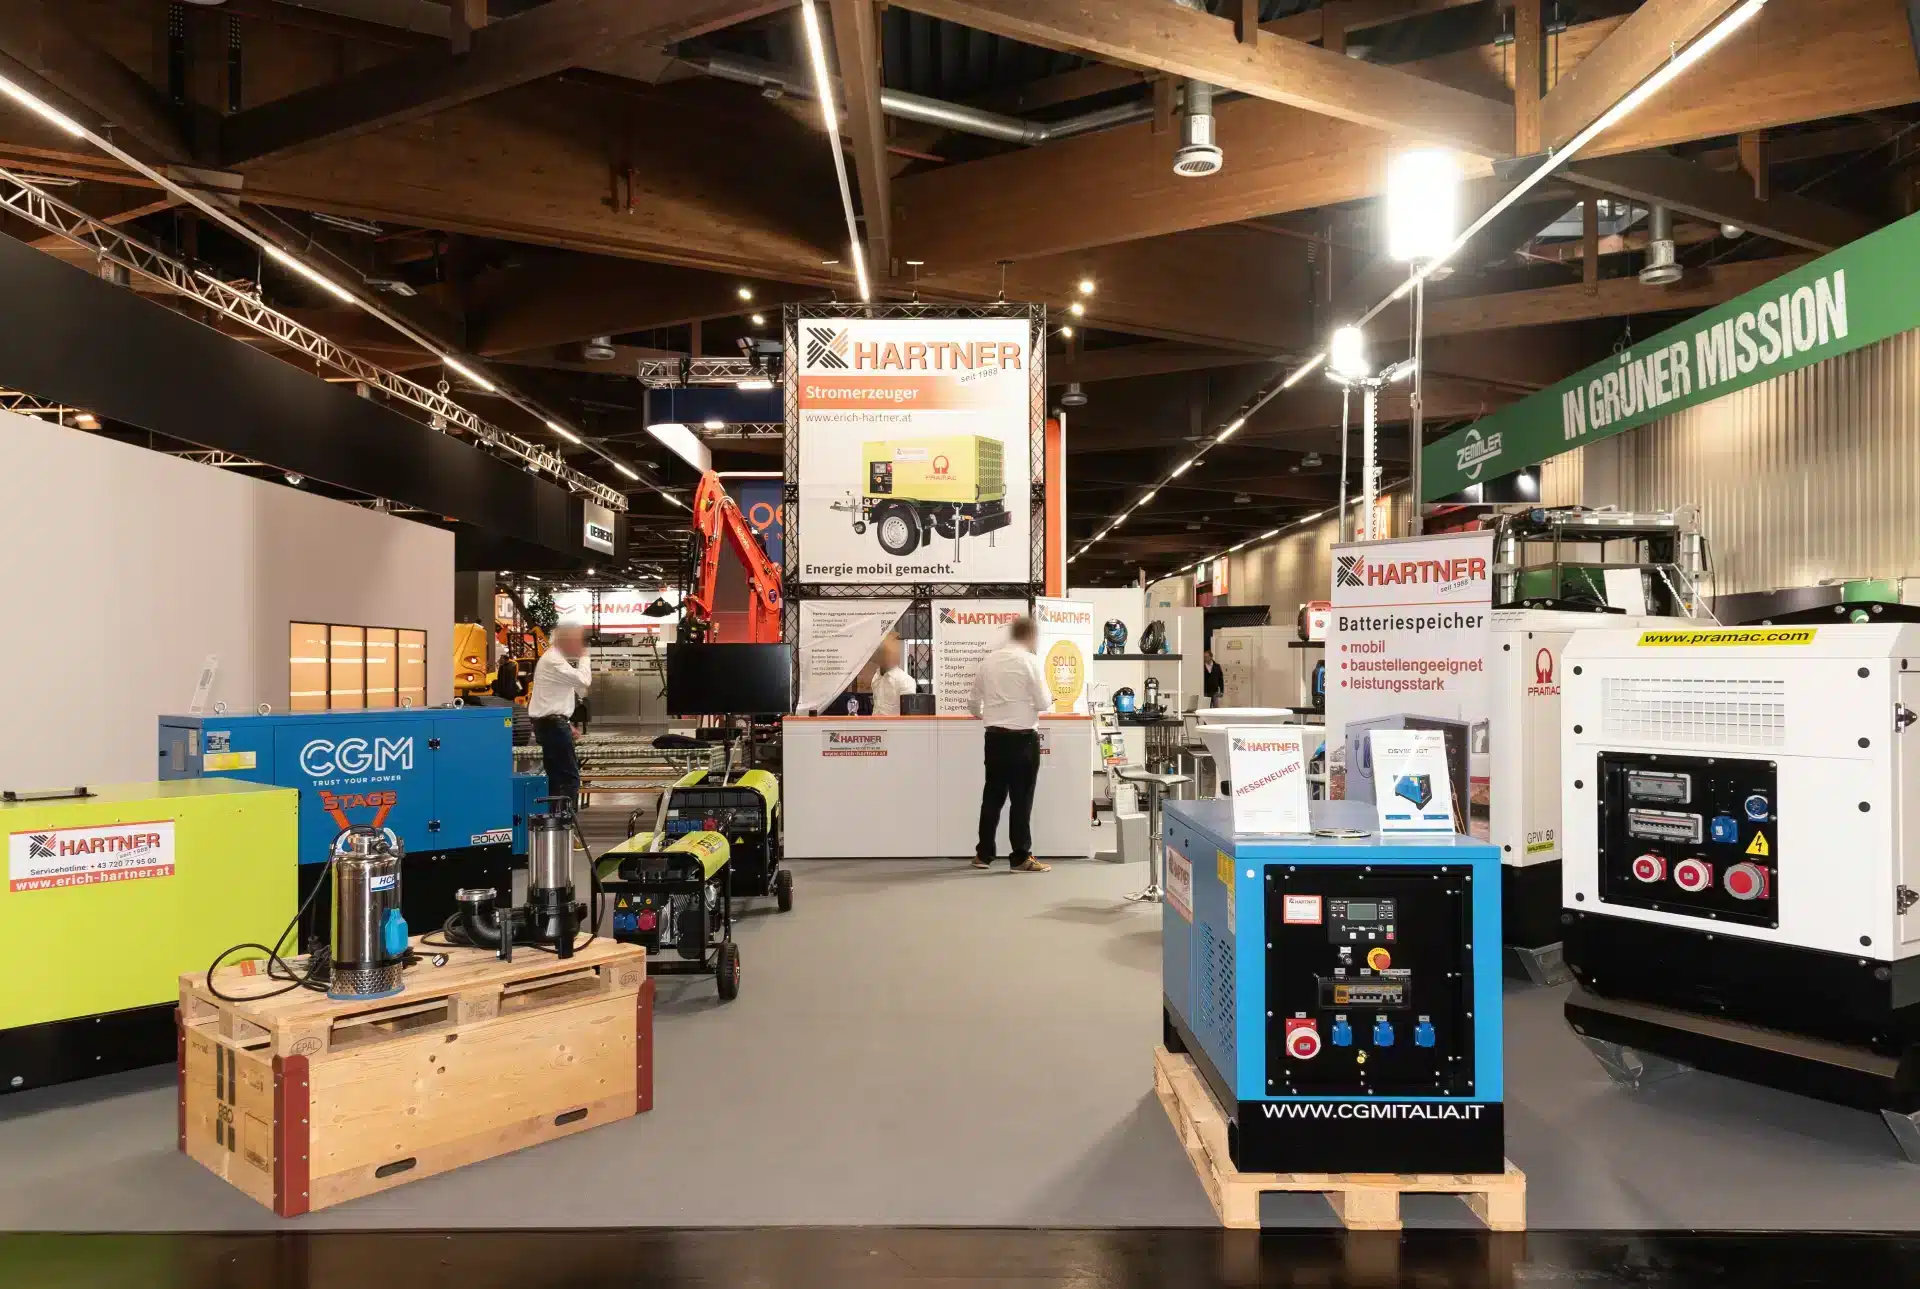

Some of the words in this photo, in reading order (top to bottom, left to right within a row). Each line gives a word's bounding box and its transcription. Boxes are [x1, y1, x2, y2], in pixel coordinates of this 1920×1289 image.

[853, 341, 1022, 370] HARTNER
[1562, 386, 1587, 441] IN
[1588, 340, 1692, 430] GRÜNER
[1695, 268, 1849, 389] MISSION
[960, 373, 976, 383] seit
[805, 385, 920, 402] Stromerzeuger
[805, 413, 912, 422] www.erich-hartner.at
[1456, 432, 1503, 470] ZEMMLER
[805, 564, 853, 577] Energie
[857, 563, 892, 574] mobil
[896, 564, 955, 577] gemacht.
[1367, 557, 1487, 586] HARTNER
[1440, 584, 1452, 593] seit
[1453, 579, 1469, 588] 1988
[1050, 611, 1091, 625] HARTNER
[1339, 612, 1484, 633] Batteriespeicher
[1645, 631, 1810, 645] www.pramac.com
[1350, 640, 1386, 653] mobil
[1052, 656, 1077, 667] SOLID
[1350, 658, 1483, 674] baustellengeeignet
[1350, 677, 1445, 692] leistungsstark
[1528, 686, 1561, 697] PRAMAC
[840, 735, 882, 743] HARTNER
[1247, 742, 1300, 752] HARTNER
[299, 736, 414, 777] CGM
[1235, 761, 1301, 797] MESSENEUHEIT
[323, 790, 397, 811] STAGE
[472, 833, 512, 845] 20kVA
[1526, 831, 1544, 844] GPW
[1545, 829, 1554, 841] 60
[60, 832, 161, 857] HARTNER
[119, 851, 132, 859] seit
[30, 864, 89, 876] Servicehotline:
[15, 867, 170, 891] www.erich-hartner.at
[295, 1039, 319, 1054] EPAL
[1262, 1104, 1485, 1119] WWW.CGMITALIA.IT
